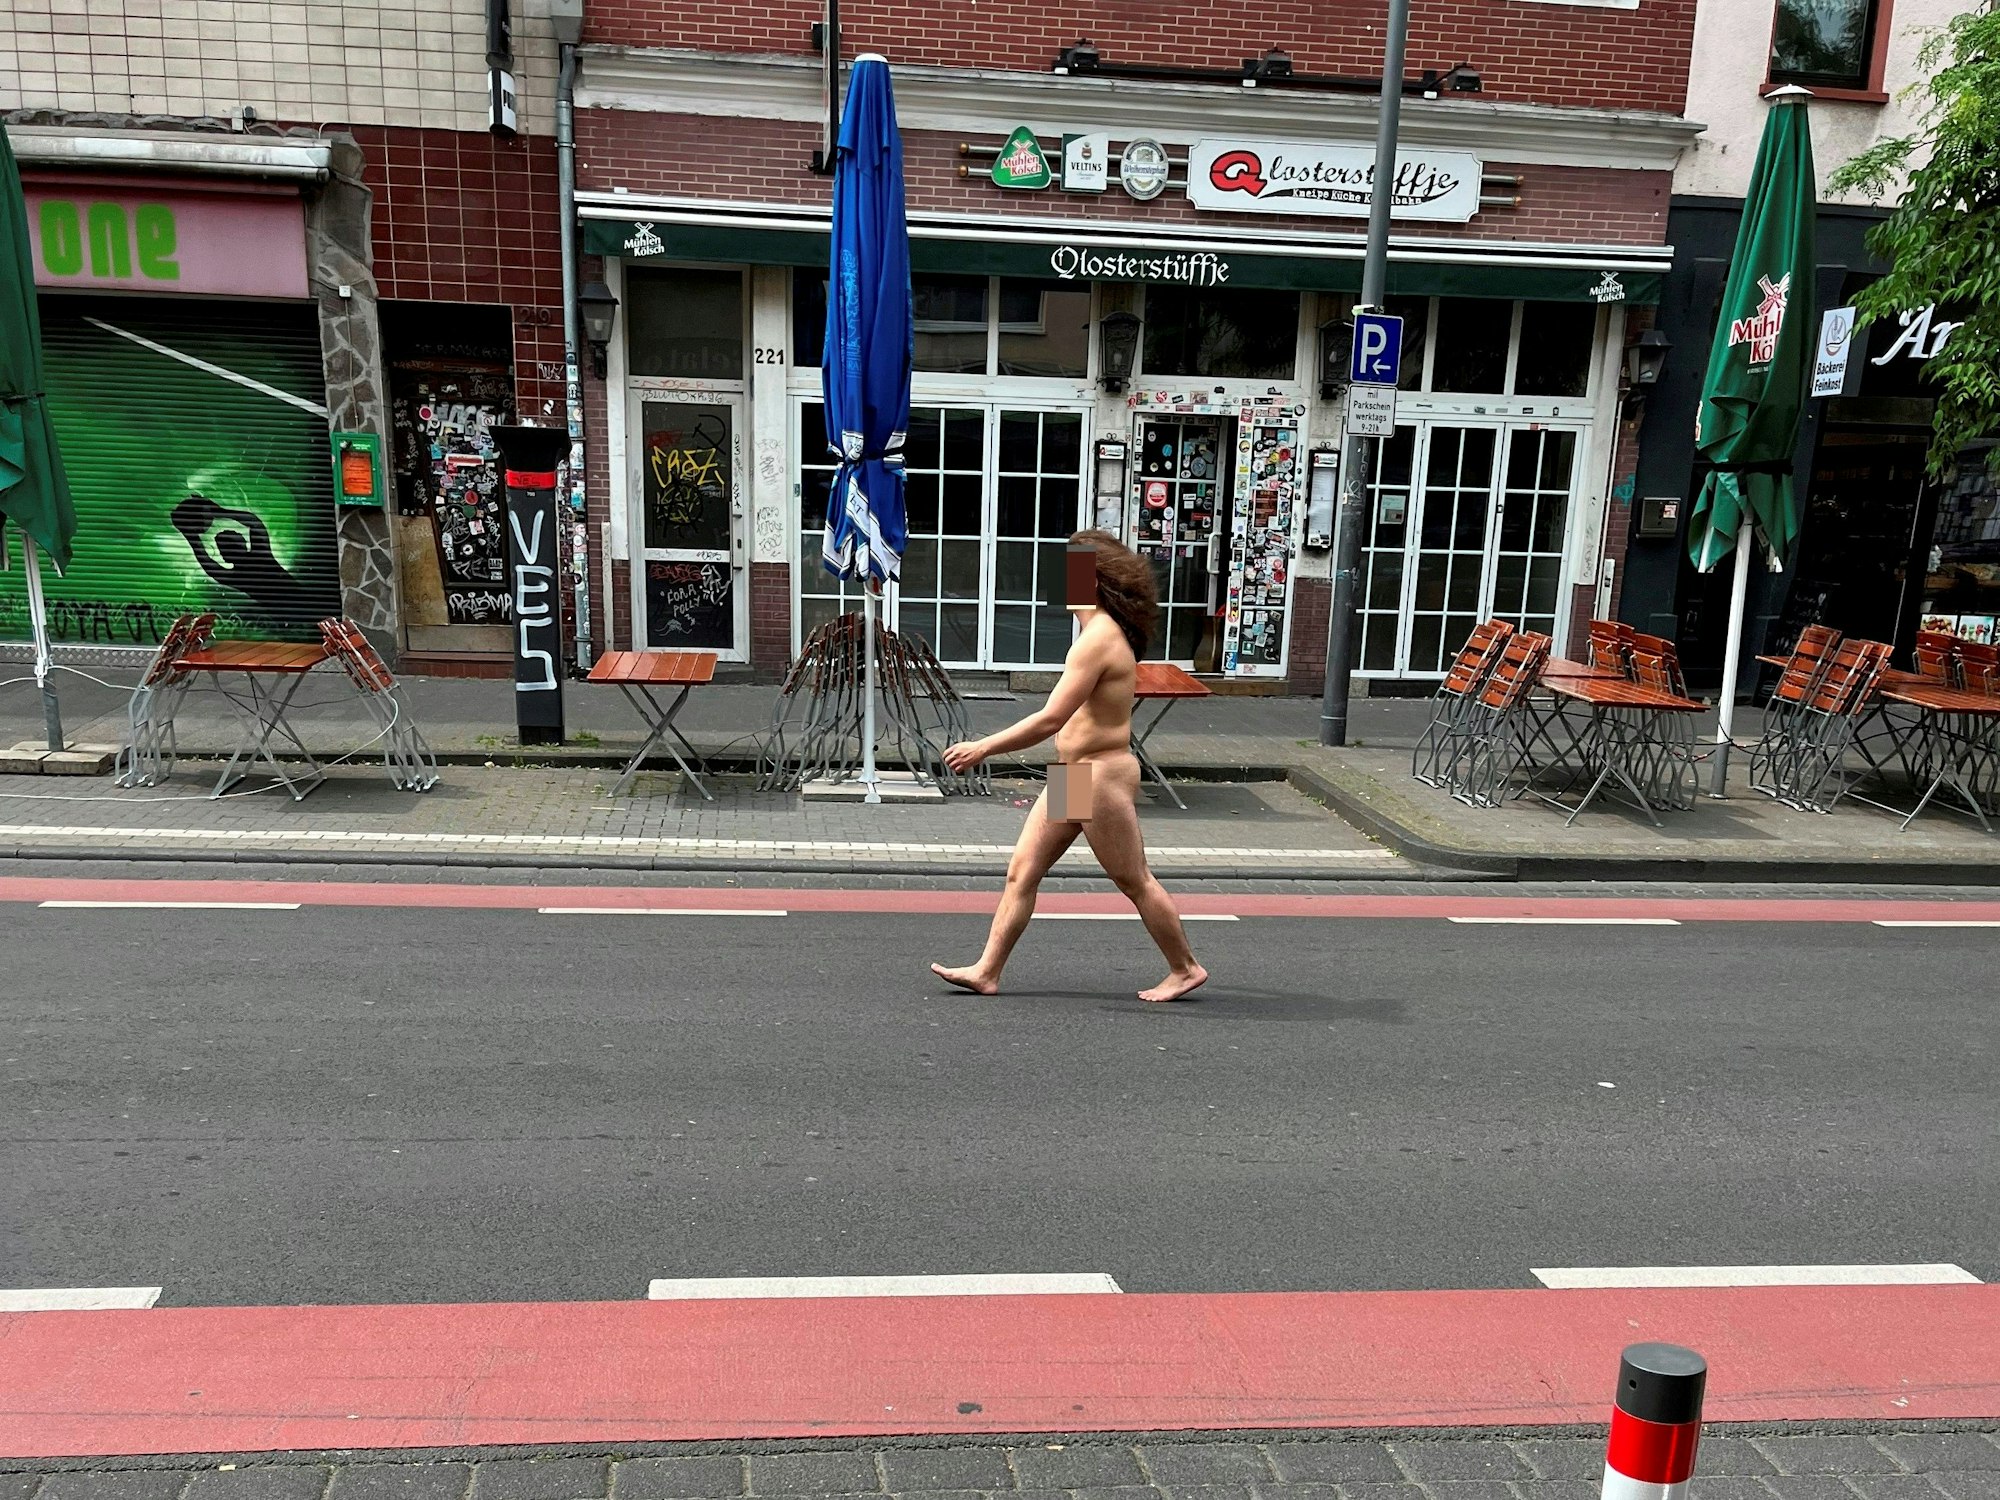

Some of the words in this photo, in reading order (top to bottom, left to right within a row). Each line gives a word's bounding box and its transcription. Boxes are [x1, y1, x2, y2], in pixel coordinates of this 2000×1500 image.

[1003, 154, 1039, 168] Mühlen
[1071, 162, 1102, 172] VELTINS
[1011, 163, 1042, 175] Kölsch
[1210, 150, 1460, 198] Qlosterstffje
[1292, 188, 1329, 199] Kneipe
[1331, 191, 1362, 203] Küche
[1363, 193, 1422, 205] Klbahn
[39, 200, 180, 281] one
[623, 236, 661, 250] Mühlen
[633, 243, 665, 257] Kölsch
[1051, 246, 1230, 287] Qlosterstüffje
[1589, 283, 1623, 297] Mühlen
[1597, 291, 1626, 304] Kölsch
[1730, 310, 1781, 344] Mühl
[1360, 323, 1388, 374] P
[754, 348, 785, 365] 221
[1817, 360, 1846, 375] Bäckerei
[1814, 378, 1841, 391] Feinkost
[1353, 400, 1391, 411] Parkschein
[1355, 412, 1387, 424] werktags
